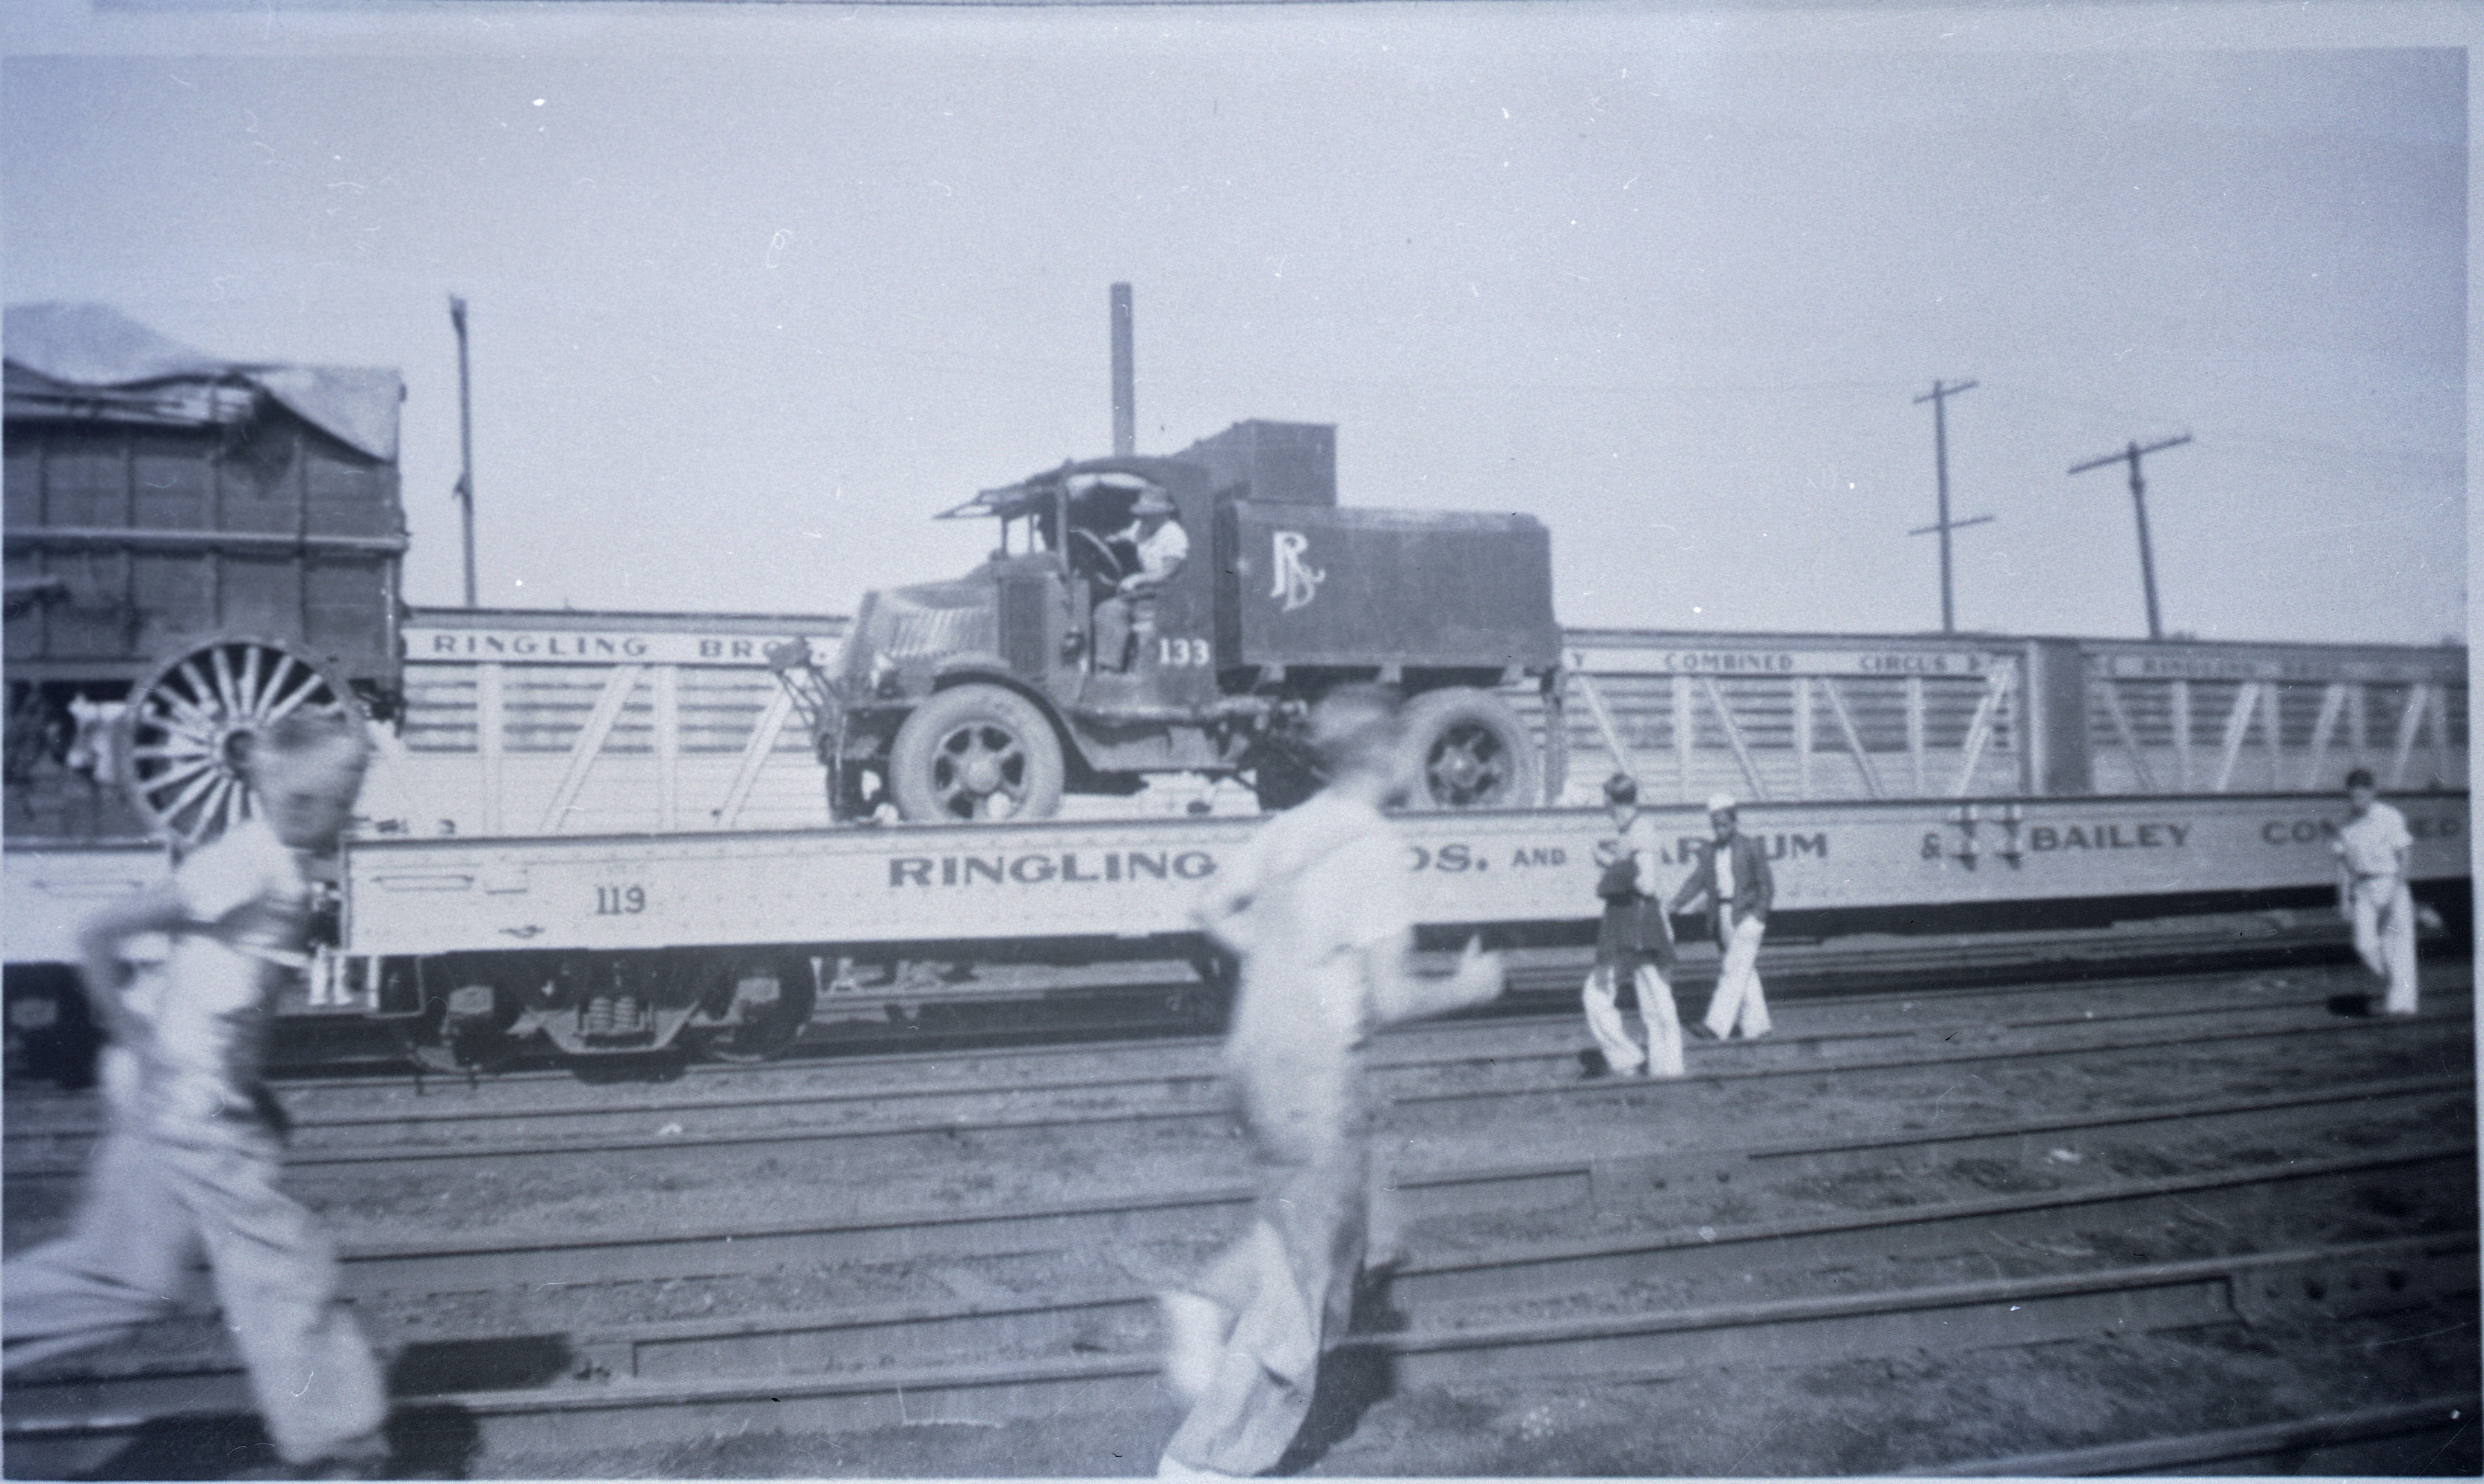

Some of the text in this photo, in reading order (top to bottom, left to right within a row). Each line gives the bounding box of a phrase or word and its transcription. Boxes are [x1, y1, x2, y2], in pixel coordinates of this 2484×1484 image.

[434, 634, 648, 657] RINGLING
[1664, 653, 1791, 672] COMBINED
[1859, 654, 1948, 673] CIRCUS
[1160, 638, 1210, 665] 133
[889, 850, 1218, 887] RINGLING
[1511, 845, 1567, 869] AND
[1921, 832, 1943, 860] &
[2030, 822, 2192, 852] BAILEY
[596, 887, 645, 915] 119
